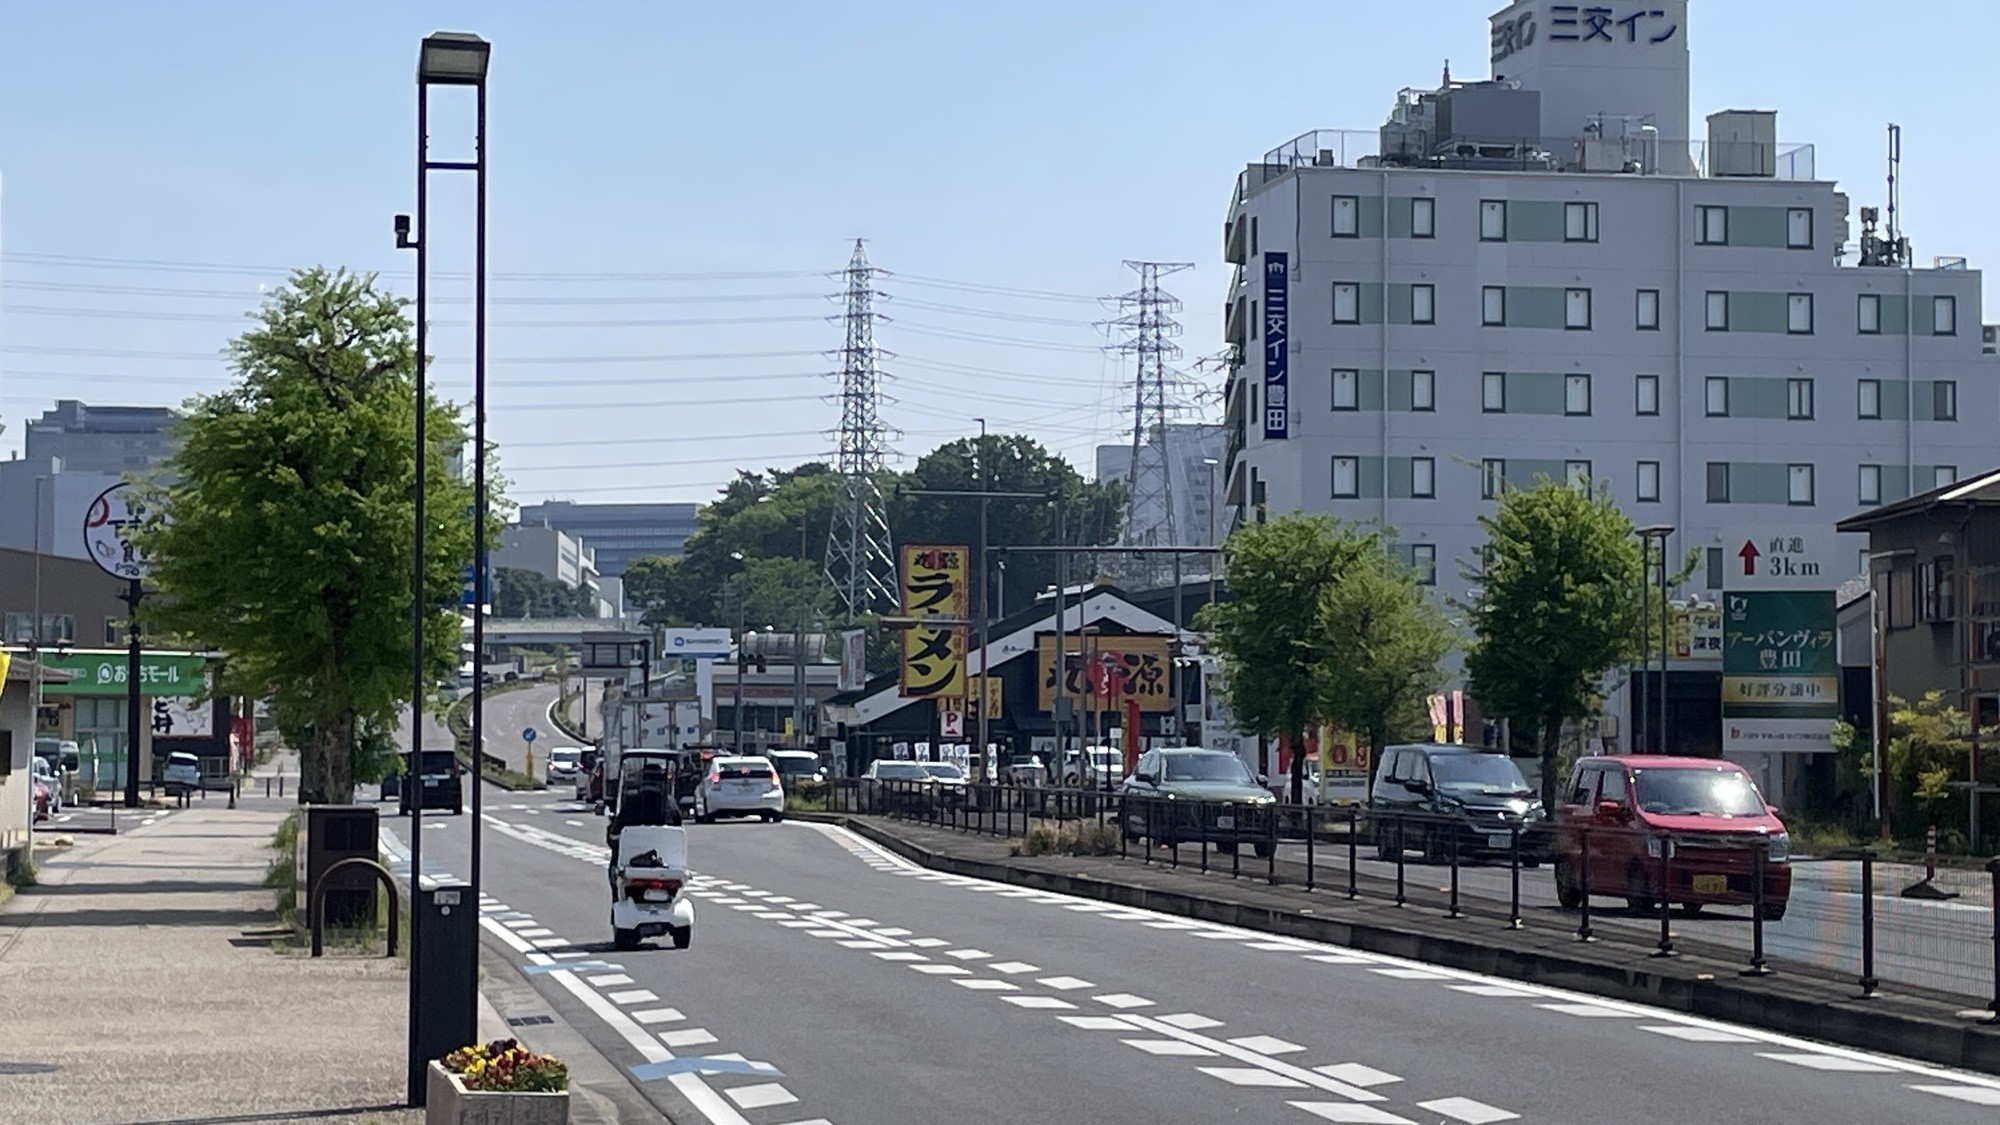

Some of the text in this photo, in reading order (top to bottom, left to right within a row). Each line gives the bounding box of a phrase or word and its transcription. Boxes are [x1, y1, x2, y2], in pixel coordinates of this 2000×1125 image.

[1551, 5, 1678, 44] 三交イン
[1267, 288, 1286, 431] 三交イン豊田
[1769, 536, 1804, 554] 直進
[1769, 556, 1820, 576] 3km
[1726, 628, 1834, 649] アーバンヴィラ
[1759, 648, 1801, 669] 豊田
[1740, 682, 1821, 698] 好評分譲中
[946, 713, 958, 728] P
